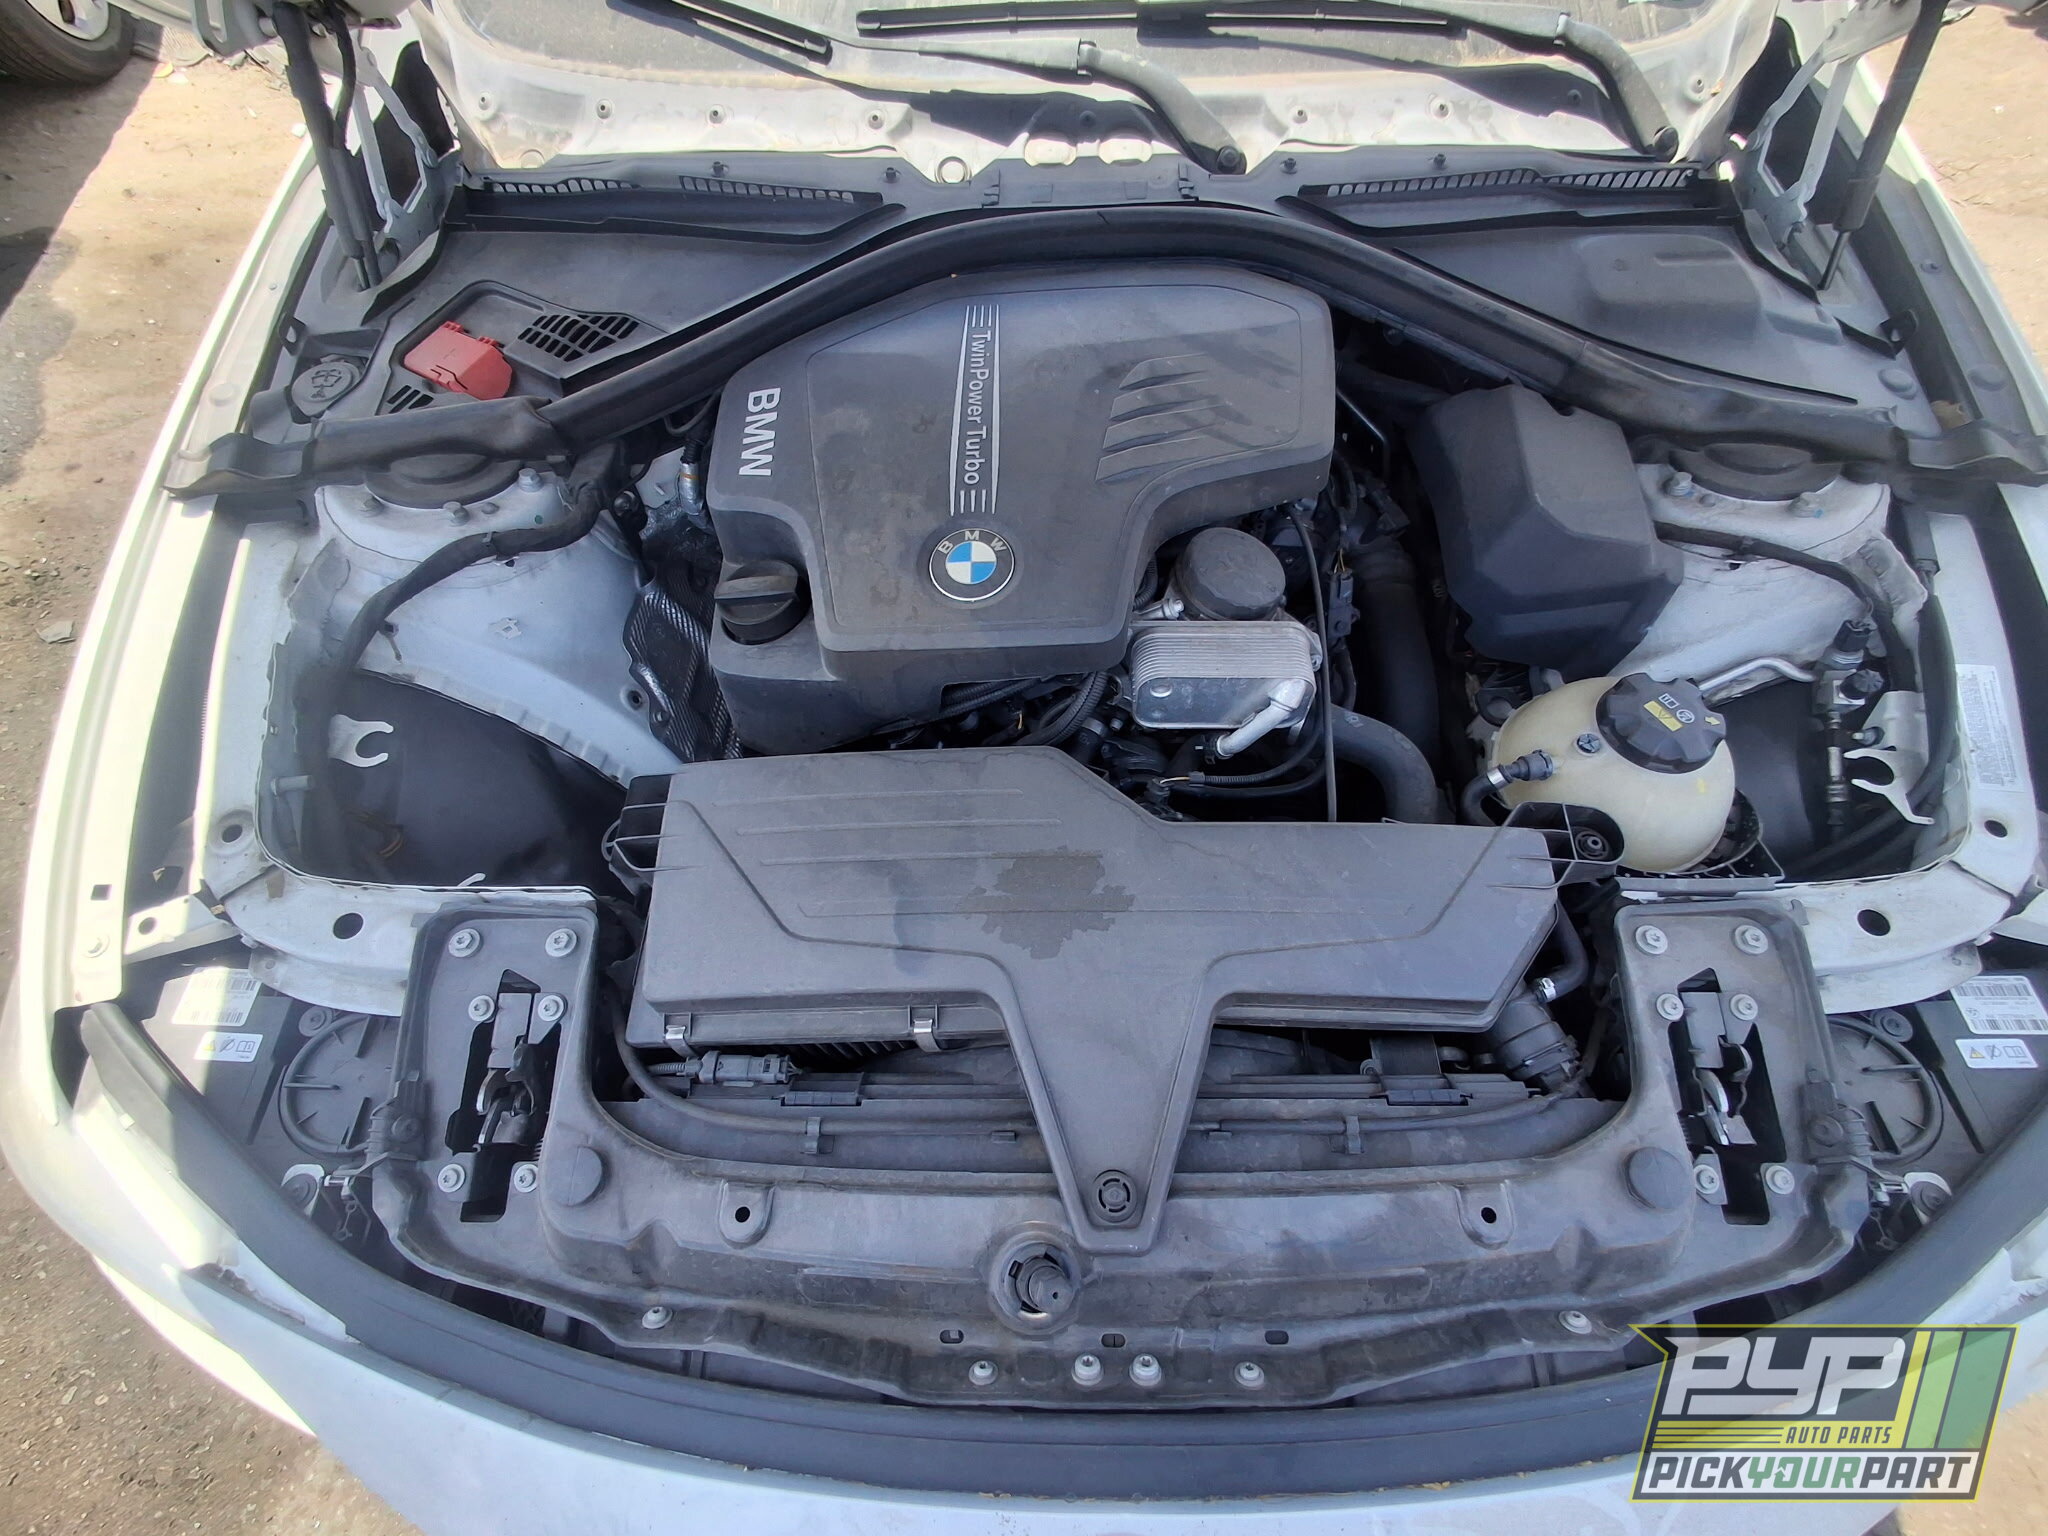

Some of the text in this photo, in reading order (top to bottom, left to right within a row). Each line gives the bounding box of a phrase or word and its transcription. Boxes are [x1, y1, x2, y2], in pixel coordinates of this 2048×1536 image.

[739, 387, 781, 476] BMW
[964, 330, 991, 485] TwinPower Turbo
[938, 530, 1007, 554] BMW
